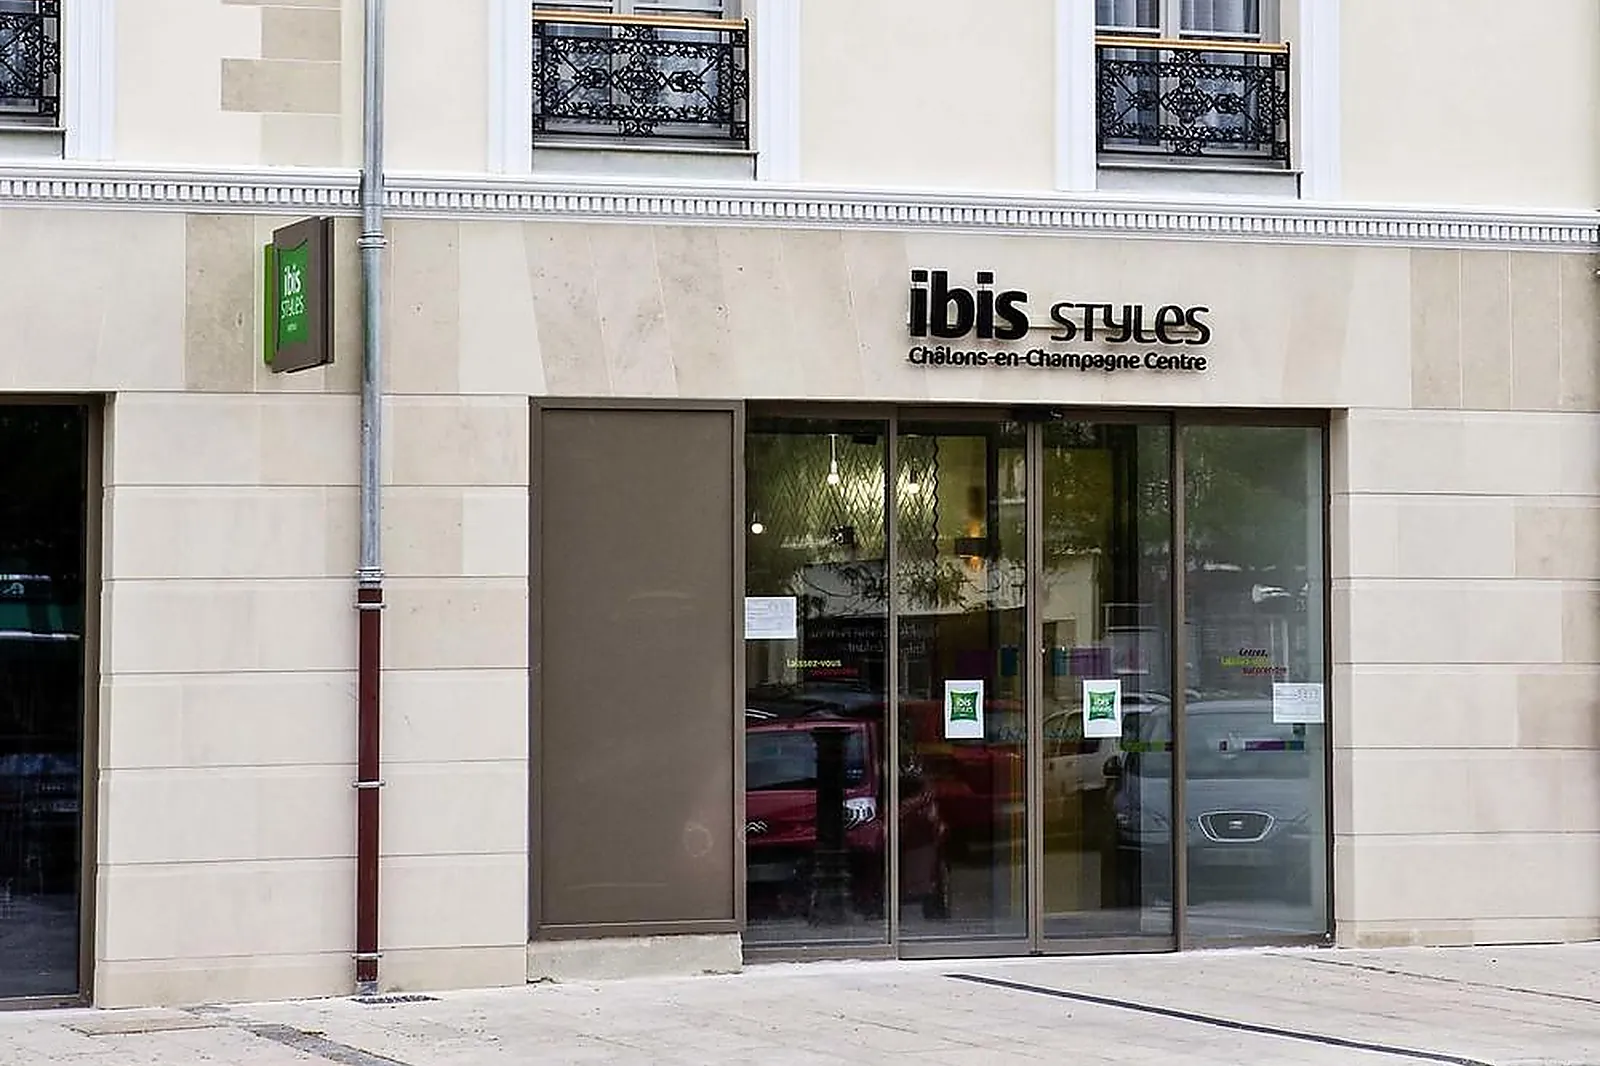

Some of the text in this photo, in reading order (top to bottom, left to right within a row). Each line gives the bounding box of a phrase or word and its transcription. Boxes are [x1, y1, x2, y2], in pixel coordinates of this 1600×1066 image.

[283, 264, 302, 297] ibis
[909, 269, 1030, 340] ibis
[909, 346, 1208, 371] Châlons-en-Champagne Centre
